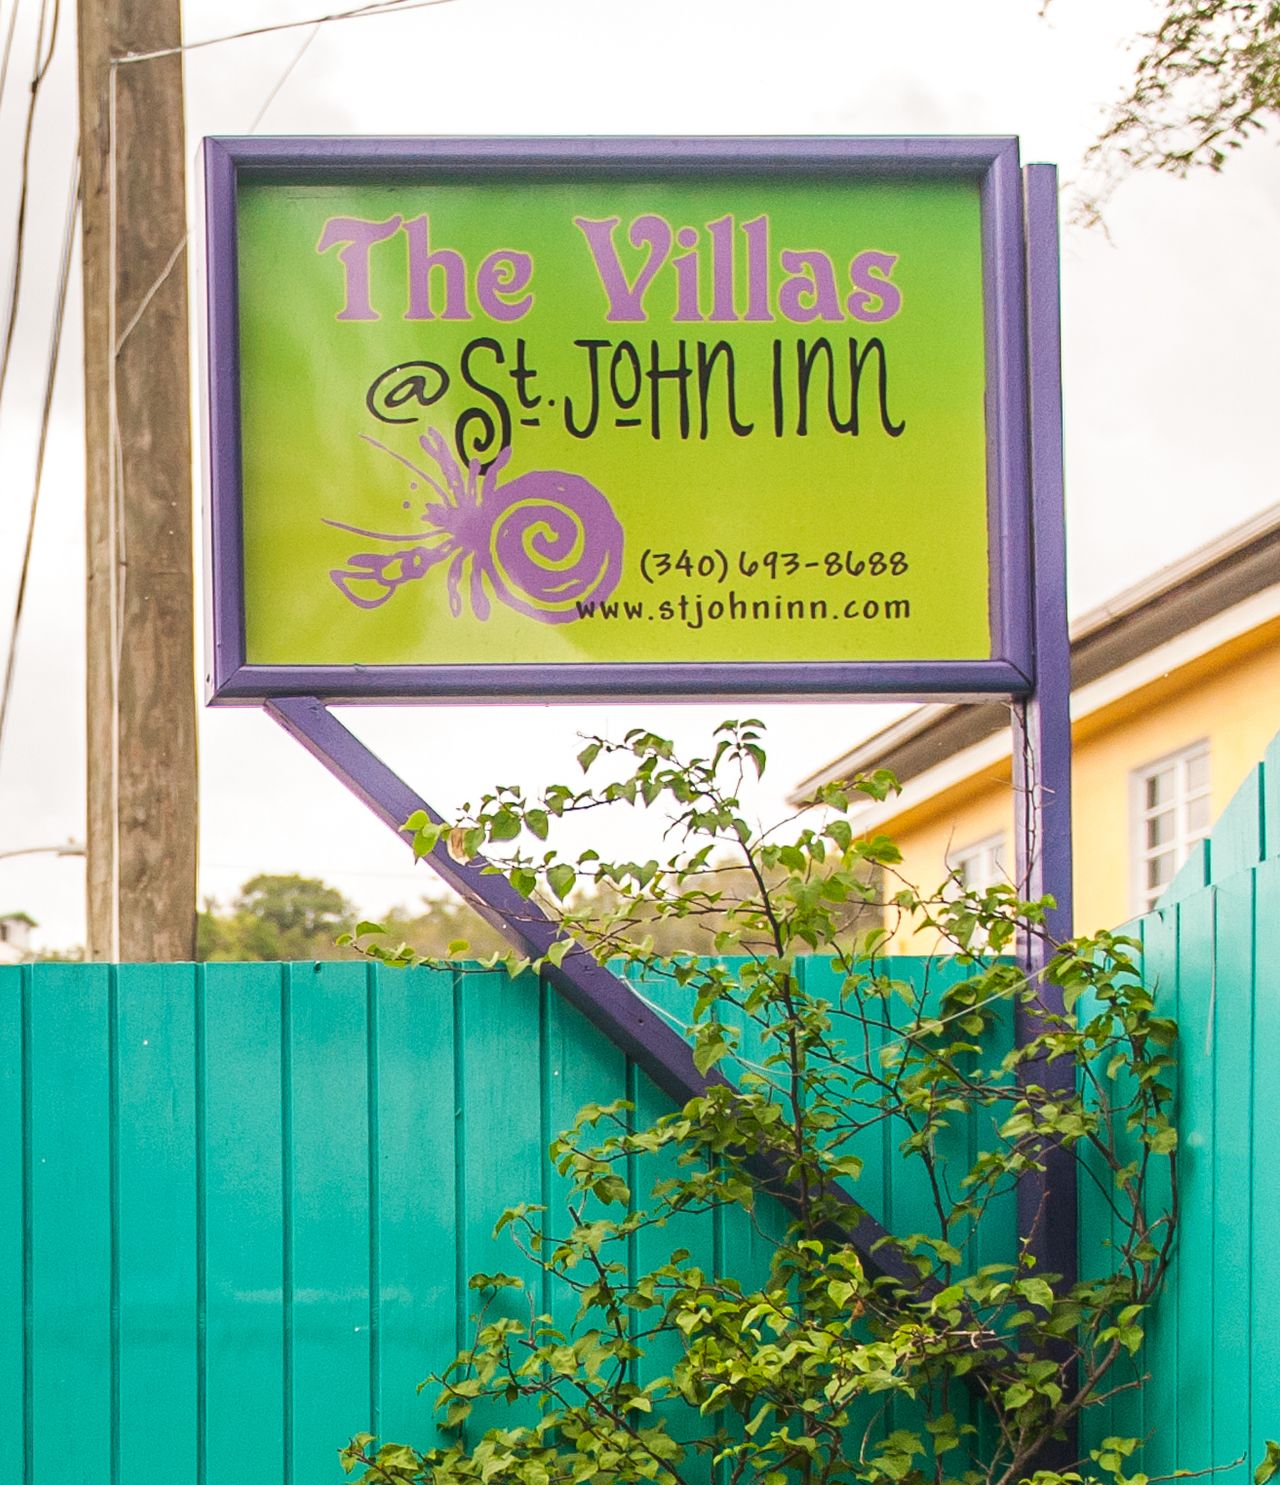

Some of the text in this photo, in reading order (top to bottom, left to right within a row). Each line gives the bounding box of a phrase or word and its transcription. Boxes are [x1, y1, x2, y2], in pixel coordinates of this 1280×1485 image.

[316, 214, 902, 323] The Villas
[640, 548, 910, 584] (340) 693-8688
[574, 590, 911, 630] www.stjohninn.com
